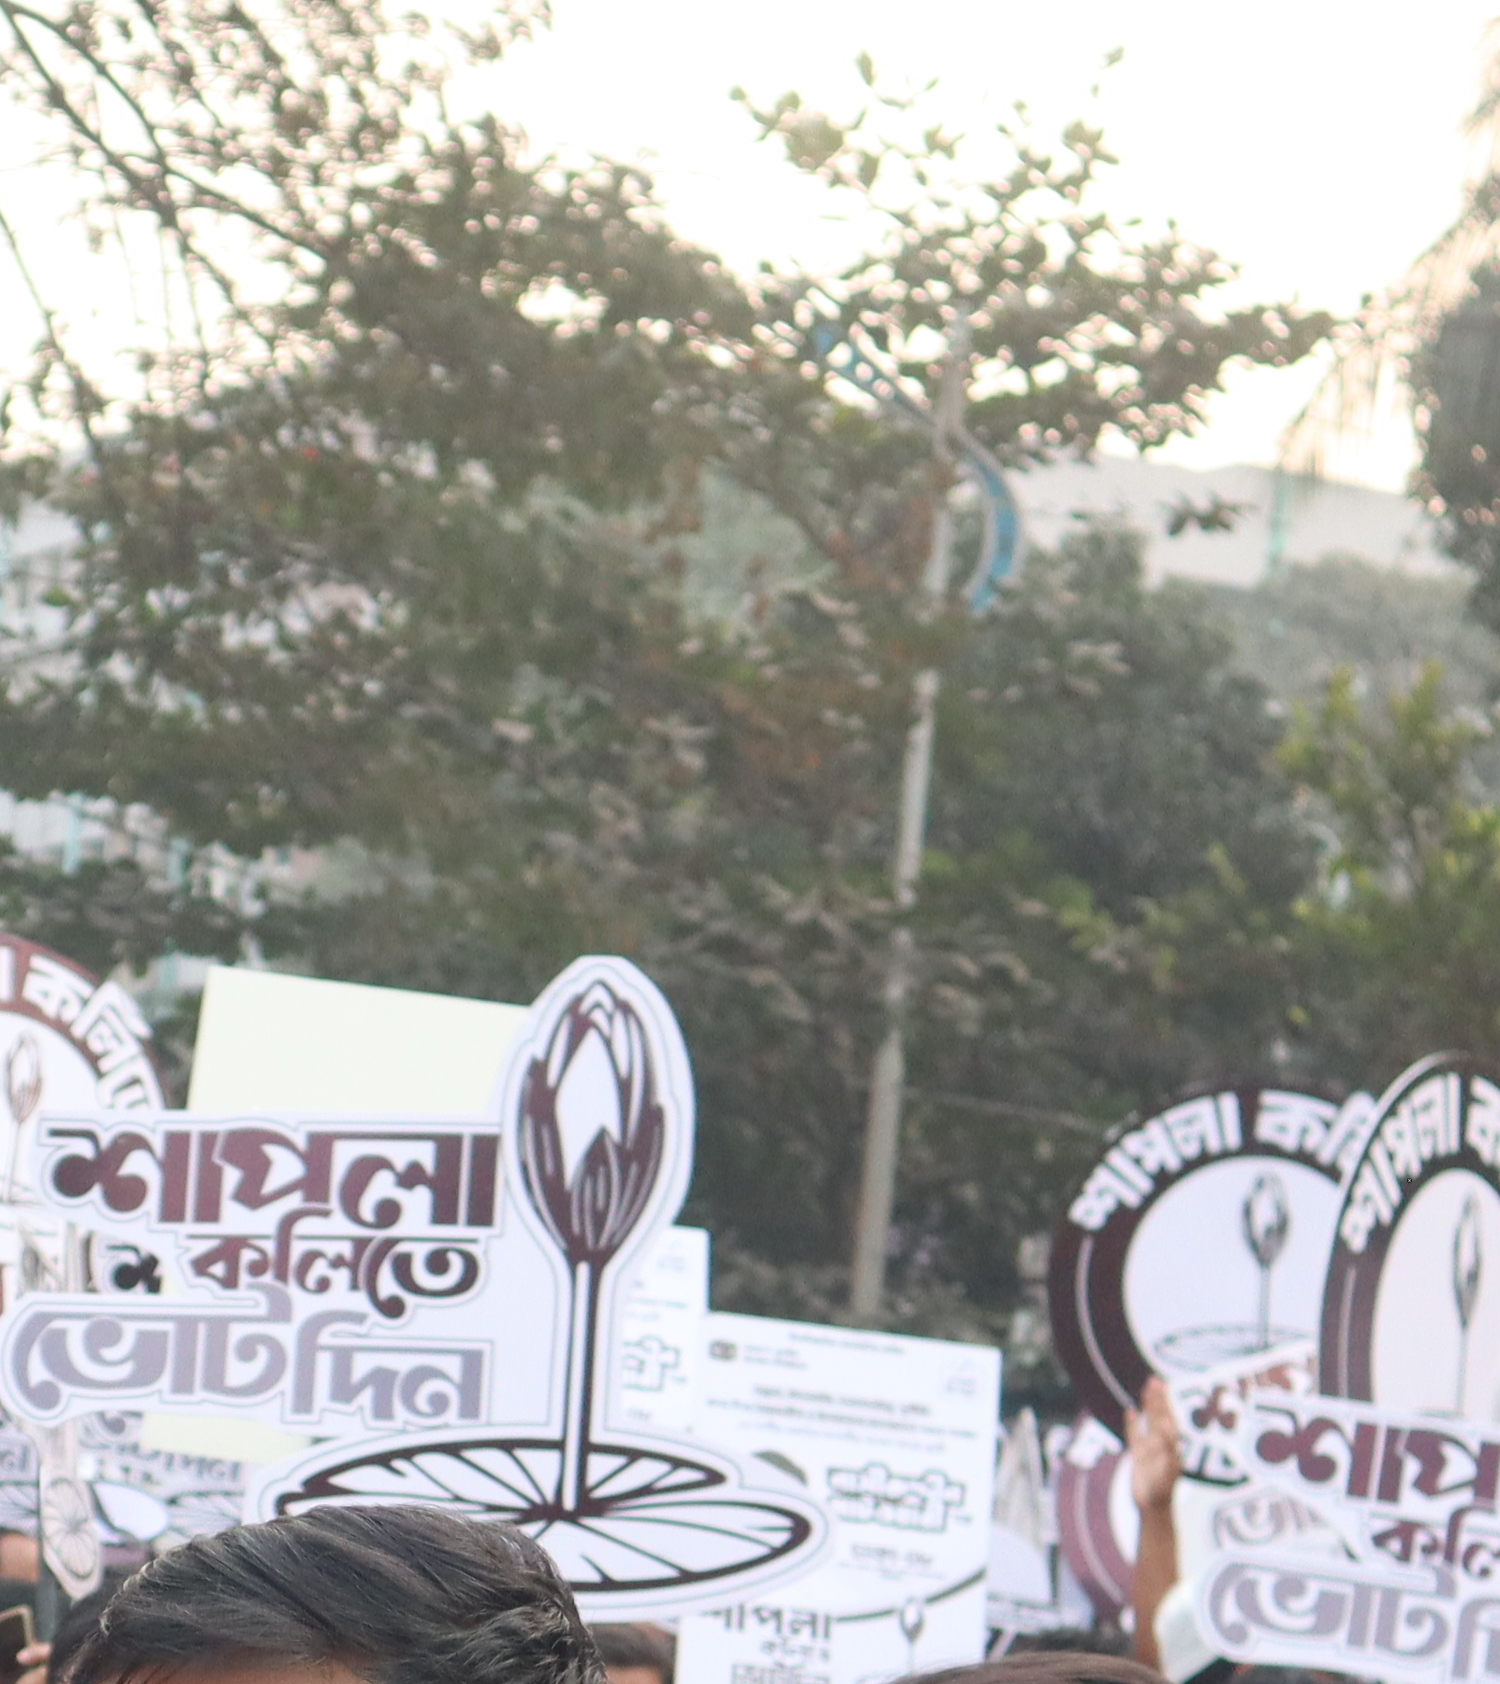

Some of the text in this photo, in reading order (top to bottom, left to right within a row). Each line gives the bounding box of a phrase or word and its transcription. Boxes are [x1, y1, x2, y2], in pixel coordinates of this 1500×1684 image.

[48, 1127, 499, 1230] শাপলা
[1068, 1091, 1243, 1231] শাপলা
[1341, 1072, 1460, 1254] শাপলা
[186, 1205, 480, 1319] কলিতে
